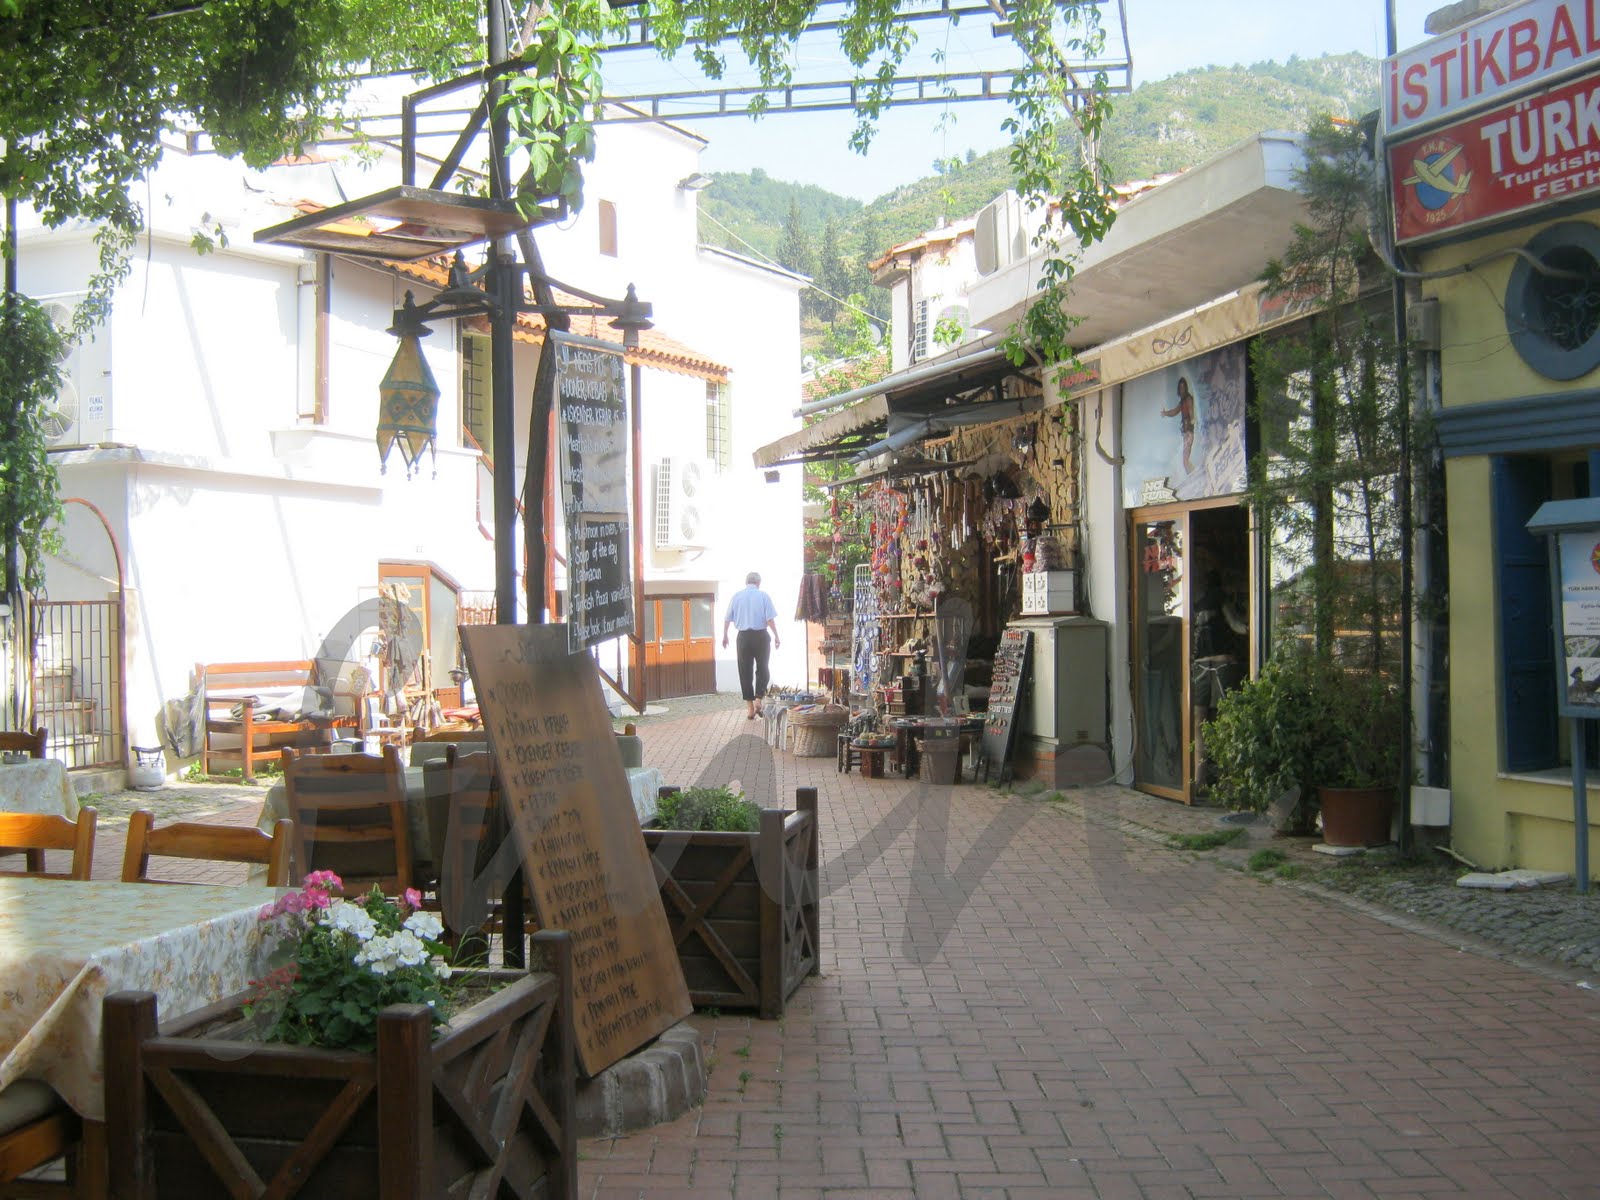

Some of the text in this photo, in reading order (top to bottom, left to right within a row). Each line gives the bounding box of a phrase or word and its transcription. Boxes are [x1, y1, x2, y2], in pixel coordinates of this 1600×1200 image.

[1480, 87, 1600, 174] TÜRK
[1499, 150, 1600, 188] Turkish
[1425, 208, 1447, 225] 1925
[574, 545, 590, 569] Soup
[599, 540, 608, 558] the
[608, 540, 618, 565] day
[574, 591, 595, 613] Turkish
[595, 589, 609, 606] Pizza
